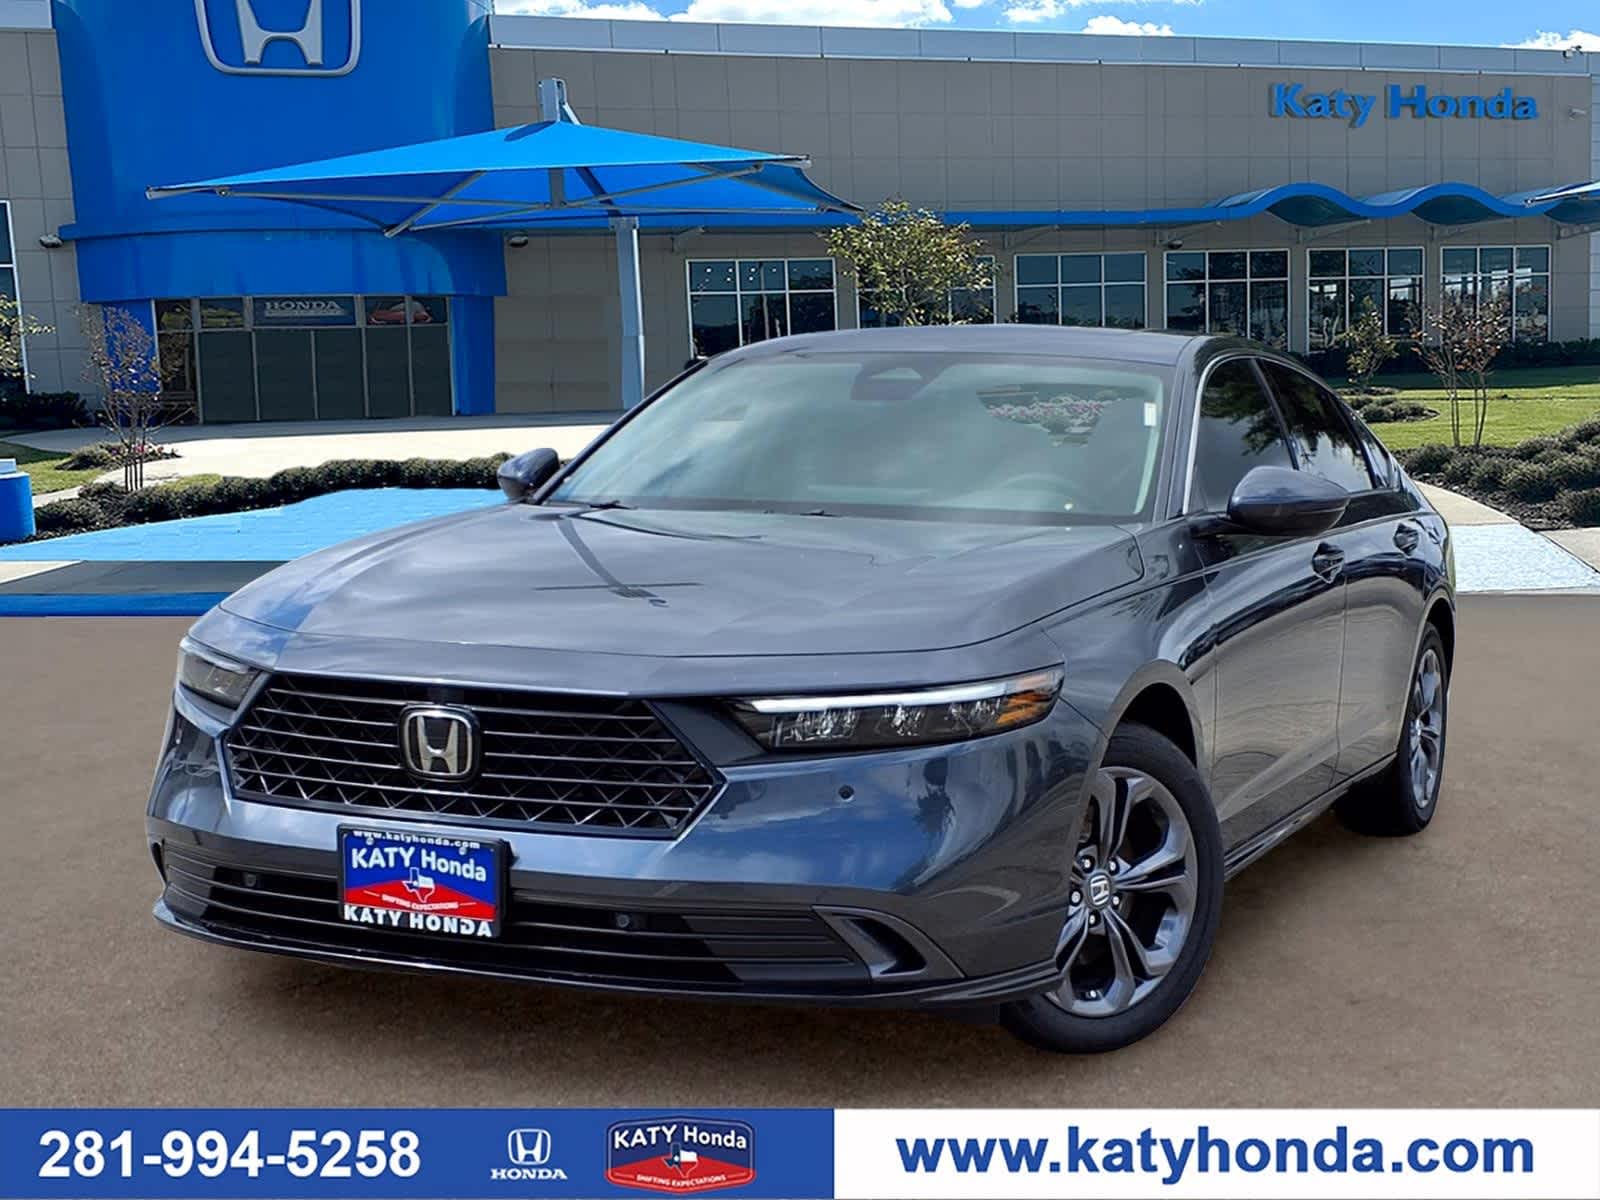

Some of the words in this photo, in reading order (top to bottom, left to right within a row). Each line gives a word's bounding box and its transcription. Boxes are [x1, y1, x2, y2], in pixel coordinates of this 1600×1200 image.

[1271, 83, 1377, 128] Katy
[1386, 84, 1539, 120] Honda
[265, 300, 343, 312] HONDA
[351, 846, 416, 869] KATY
[420, 848, 487, 882] Honda
[343, 904, 403, 927] KATY
[409, 913, 493, 938] HONDA
